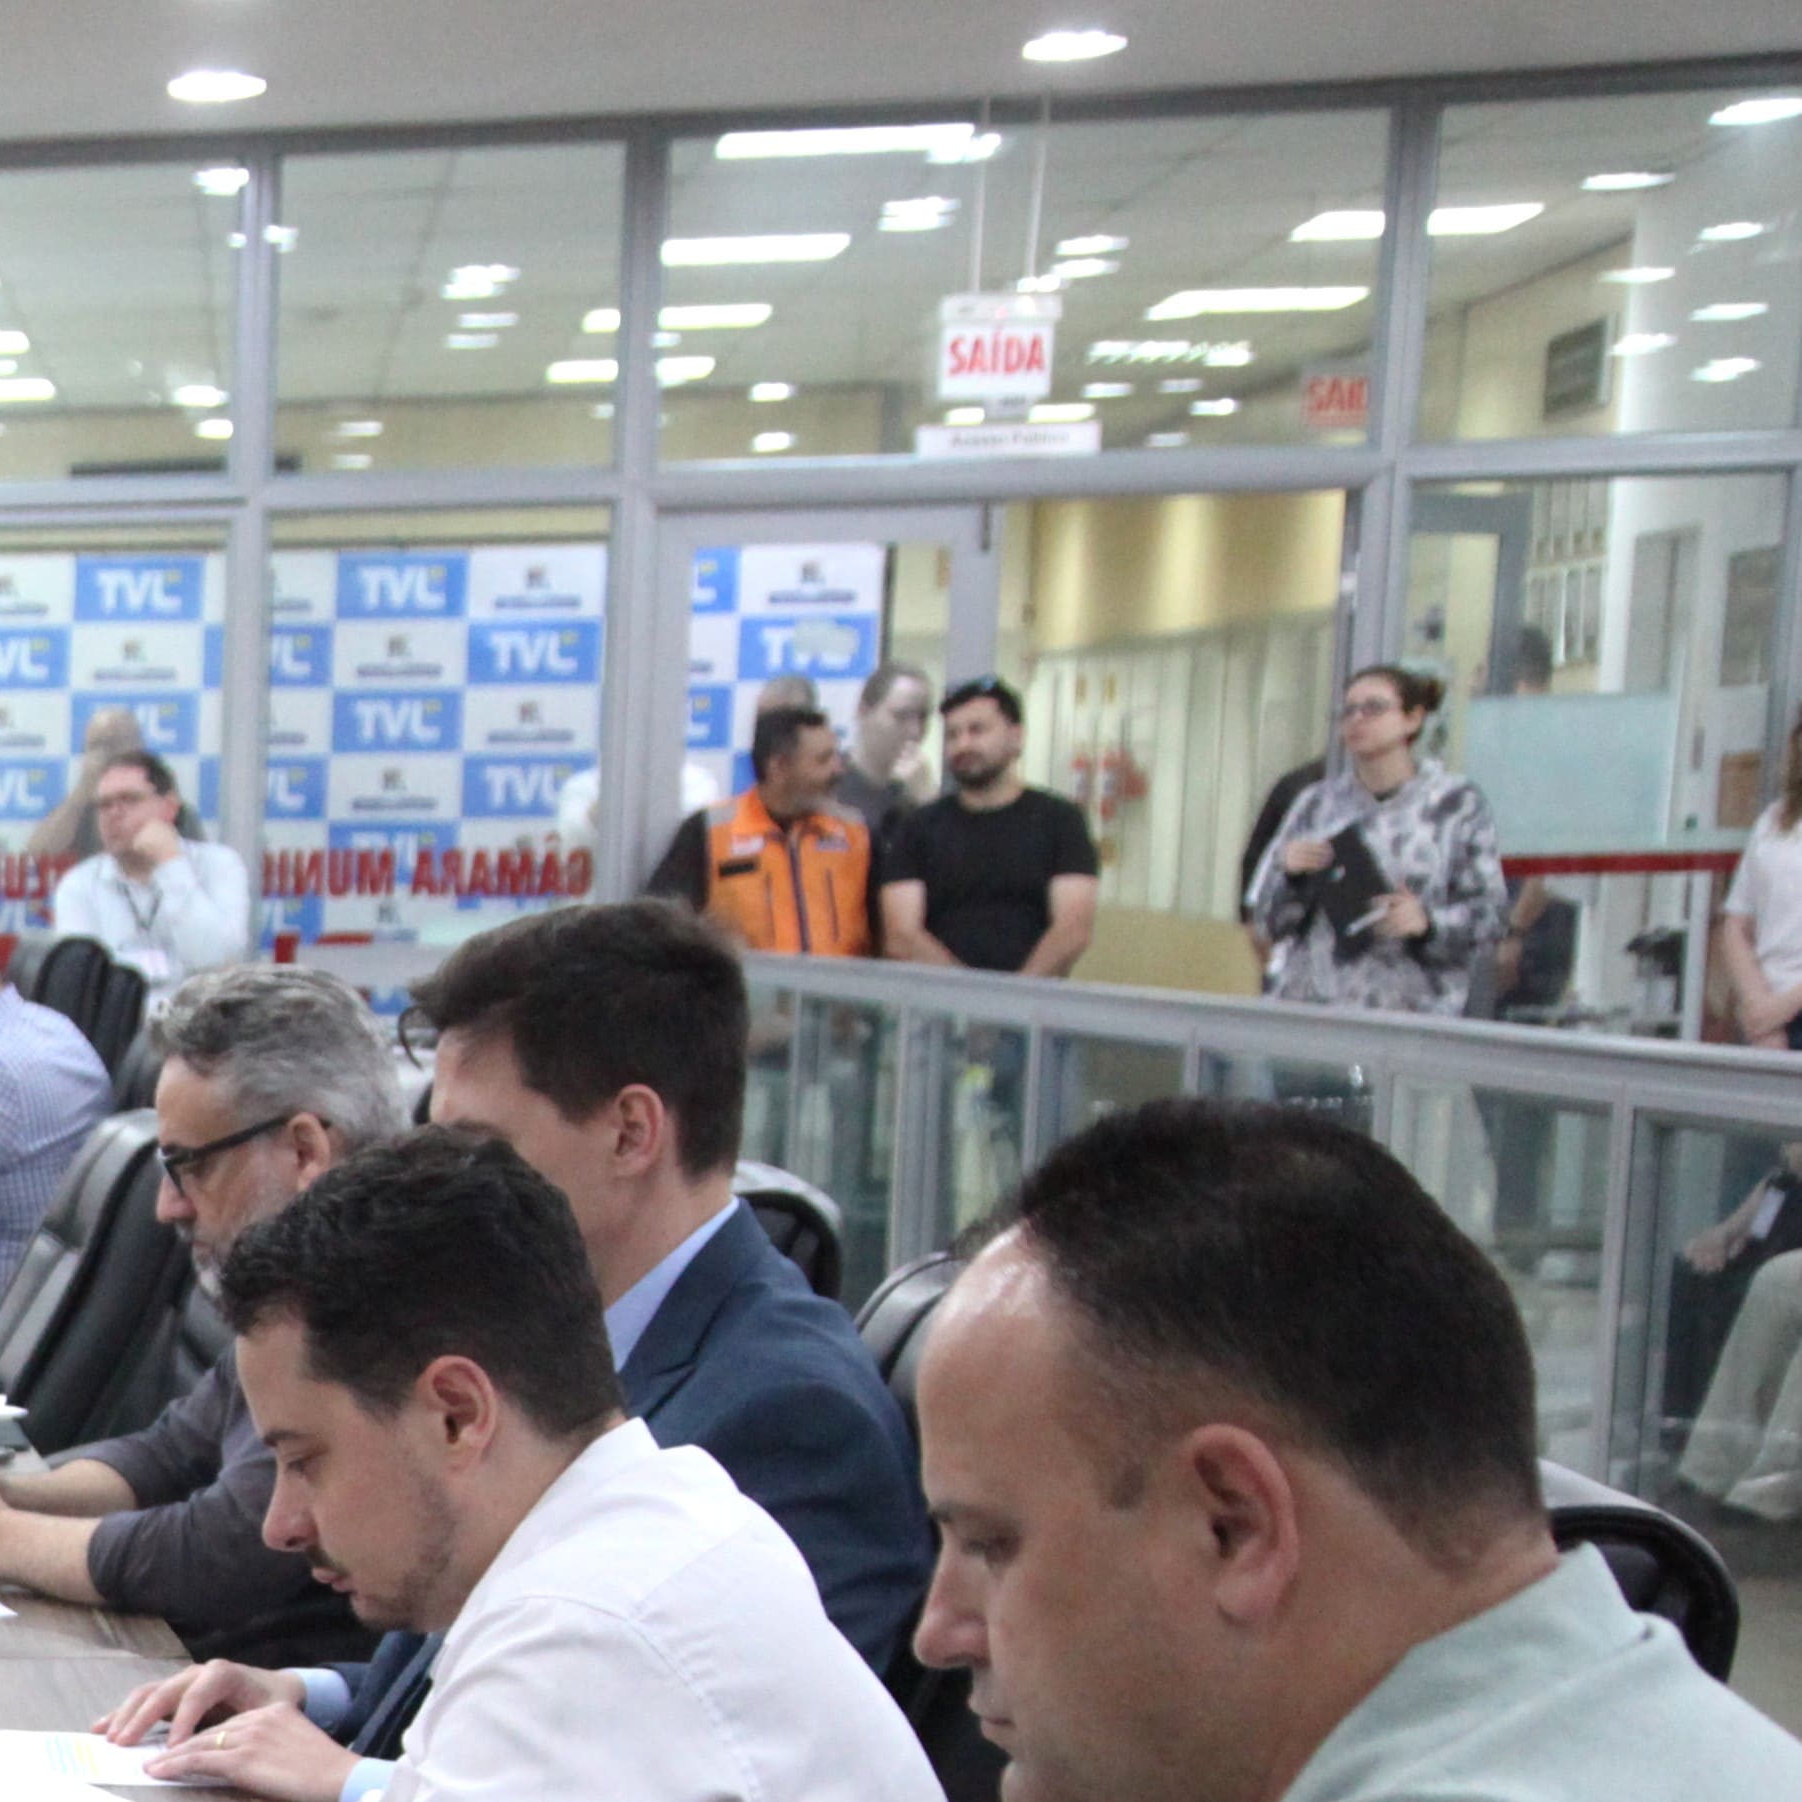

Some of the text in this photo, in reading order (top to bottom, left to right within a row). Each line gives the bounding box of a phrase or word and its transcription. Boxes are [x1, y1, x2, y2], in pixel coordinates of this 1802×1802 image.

[97, 568, 183, 613] TVL
[360, 565, 445, 611] TVL
[490, 630, 577, 675] TVL
[355, 699, 441, 743] TVL
